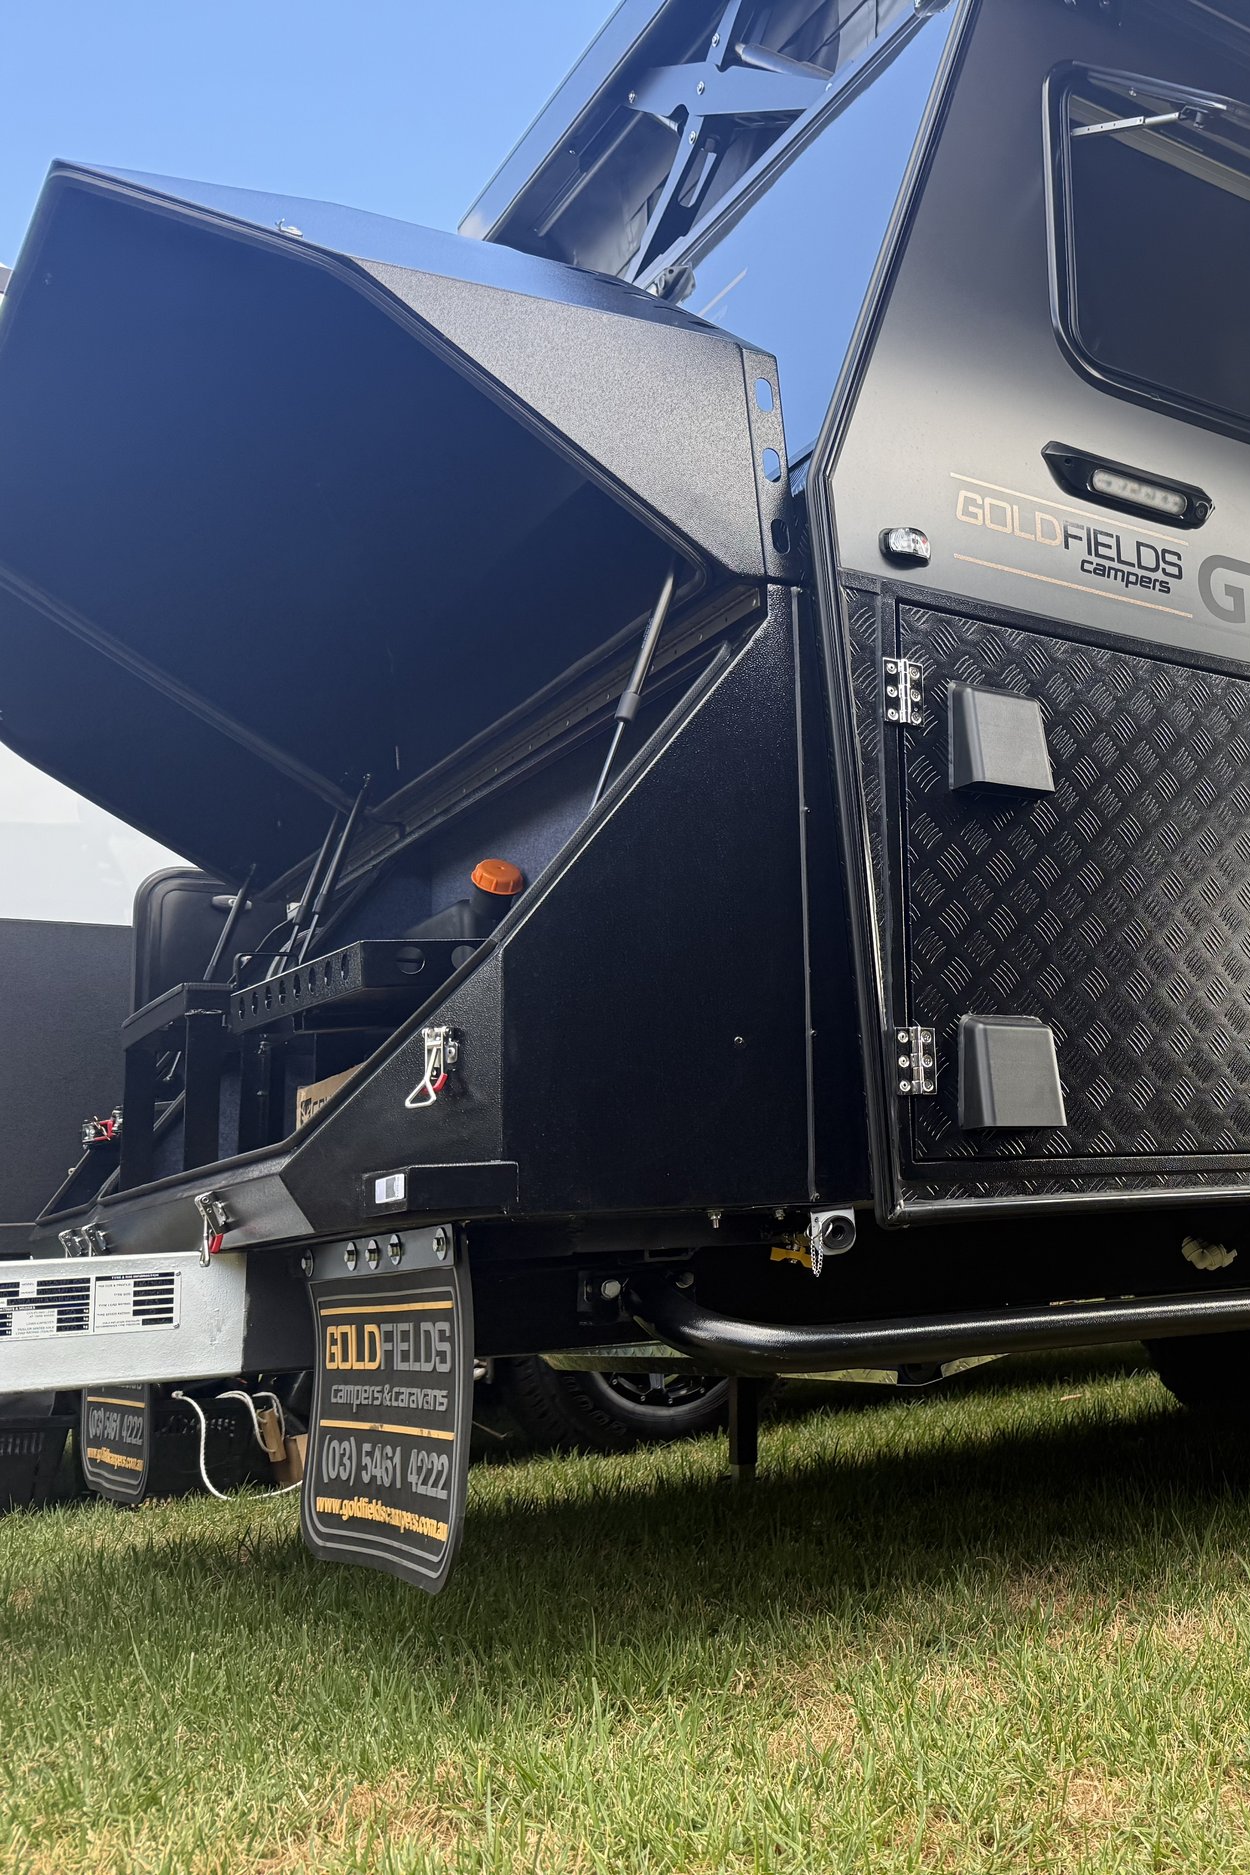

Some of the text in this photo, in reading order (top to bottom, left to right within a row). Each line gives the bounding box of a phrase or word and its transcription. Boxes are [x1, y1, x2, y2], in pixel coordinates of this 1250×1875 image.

[956, 490, 1184, 581] GOLDFIELDS
[1080, 558, 1171, 594] campers
[326, 1322, 452, 1373] GOLDFIELDS
[322, 1435, 449, 1500] (03) 5461 4222
[316, 1496, 449, 1542] www.goldfieldscampers.com.au
